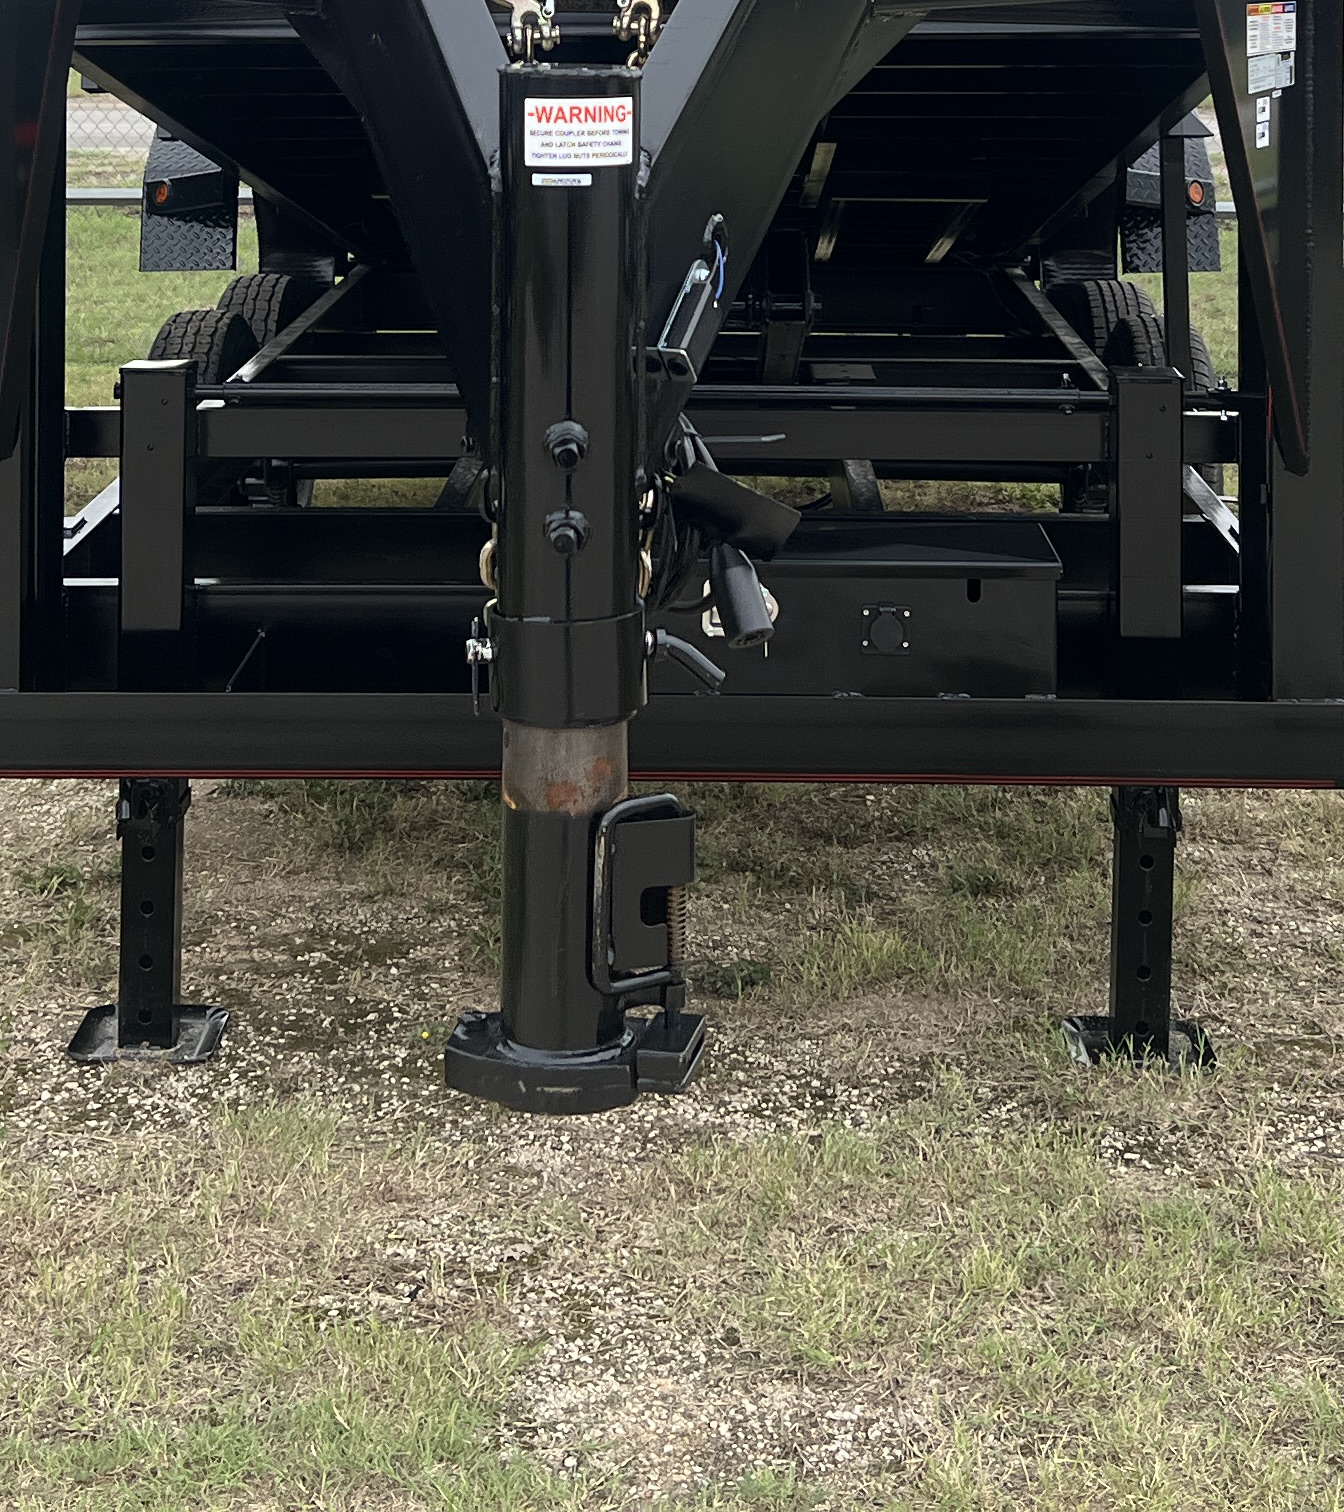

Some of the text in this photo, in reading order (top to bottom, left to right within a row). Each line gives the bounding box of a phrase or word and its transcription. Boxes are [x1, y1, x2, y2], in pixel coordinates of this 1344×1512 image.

[528, 104, 632, 124] -WARNING-
[529, 129, 554, 137] SECURE
[555, 129, 585, 137] COUPLER
[577, 140, 602, 148] SAFETY
